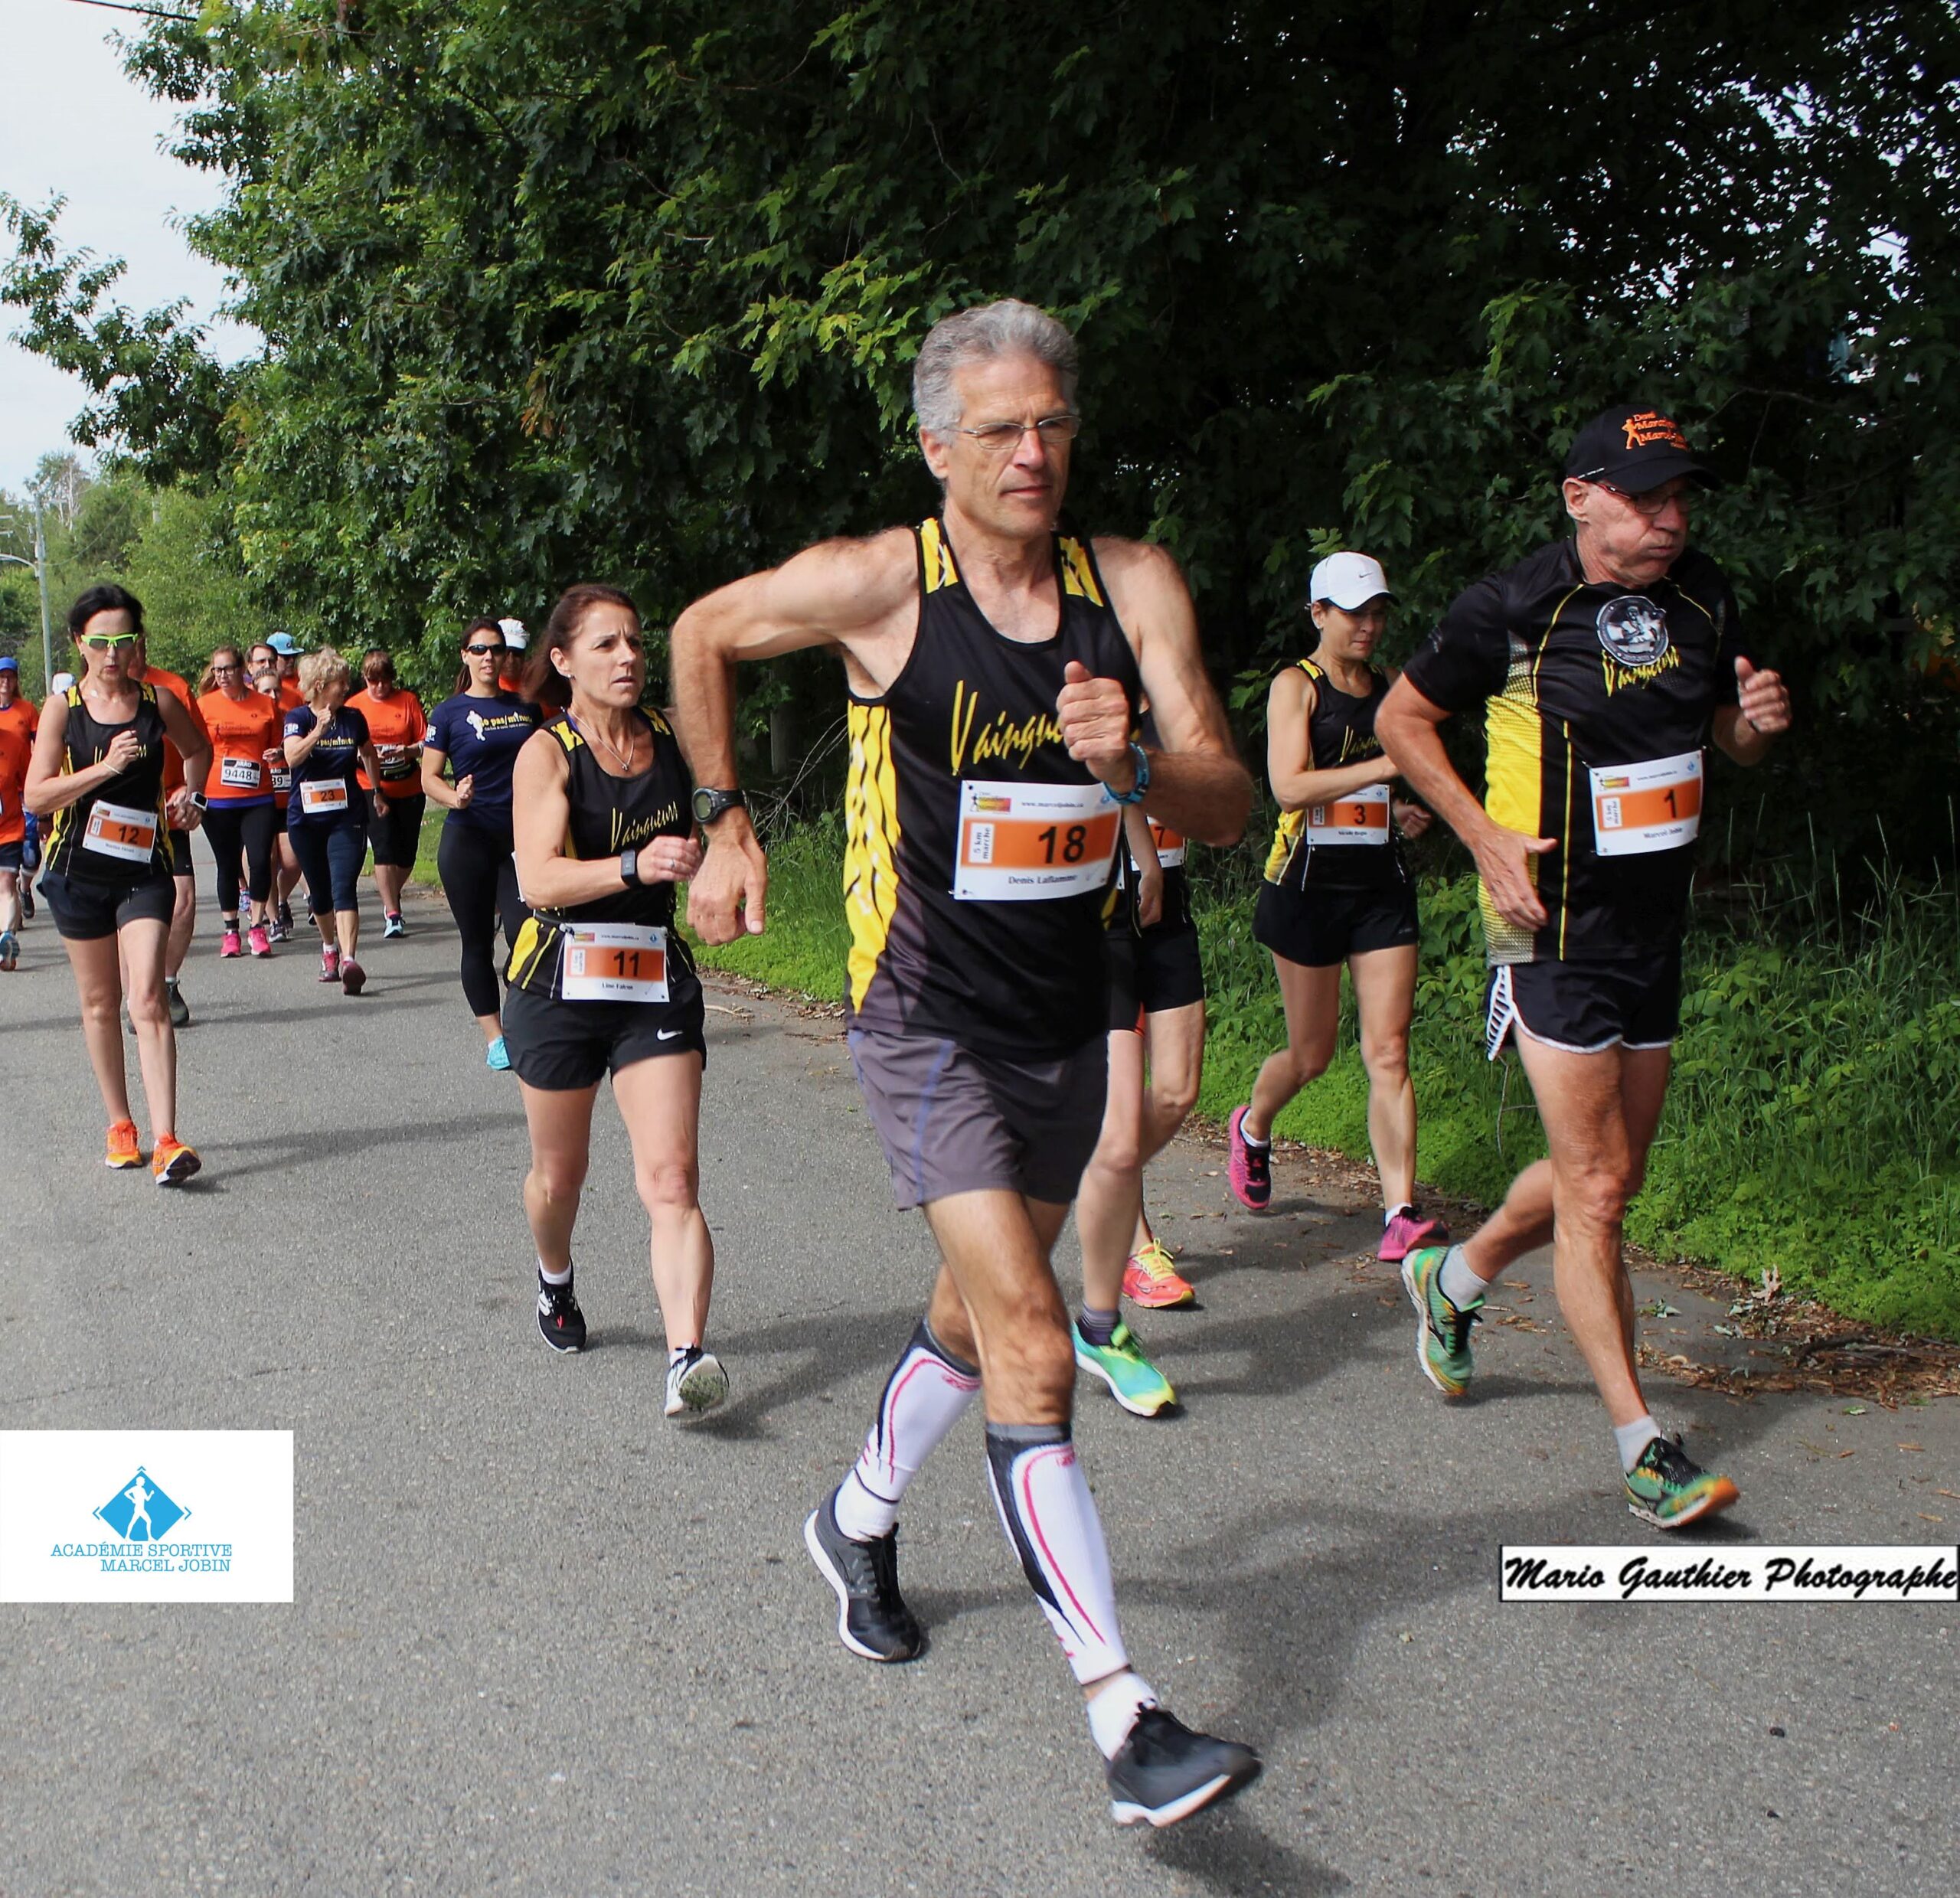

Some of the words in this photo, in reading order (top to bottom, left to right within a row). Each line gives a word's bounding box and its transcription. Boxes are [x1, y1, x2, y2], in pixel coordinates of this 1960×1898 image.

[952, 679, 1064, 776] Vainqu
[224, 768, 253, 782] 9448
[320, 791, 335, 802] 23
[1664, 789, 1677, 818] 1
[1354, 804, 1367, 825] 3
[119, 825, 139, 844] 12
[1038, 825, 1086, 864] 18
[1008, 876, 1034, 885] Denis
[613, 950, 640, 978] 11
